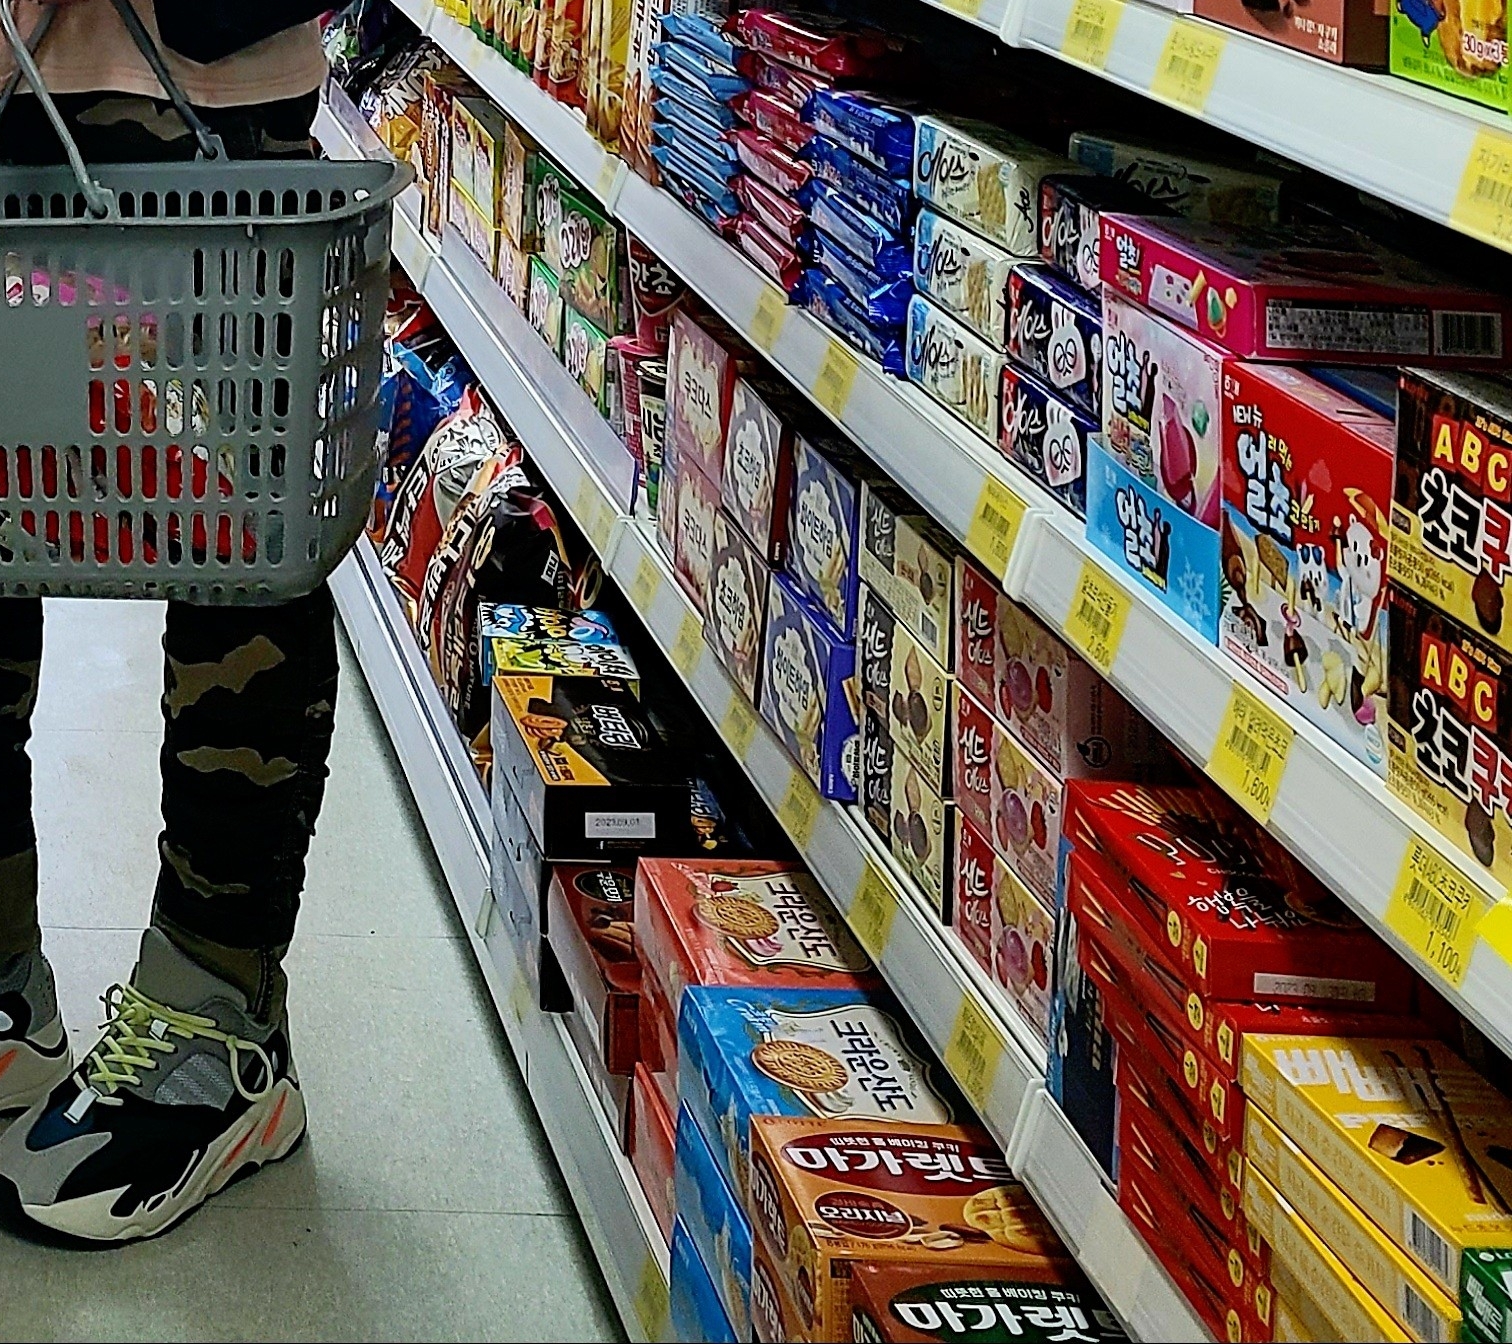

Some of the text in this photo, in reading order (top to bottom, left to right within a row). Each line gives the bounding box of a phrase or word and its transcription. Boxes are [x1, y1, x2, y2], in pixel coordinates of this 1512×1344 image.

[1432, 415, 1512, 501] ABC
[1422, 631, 1498, 734] ABC
[819, 1204, 906, 1225] 오리지널
